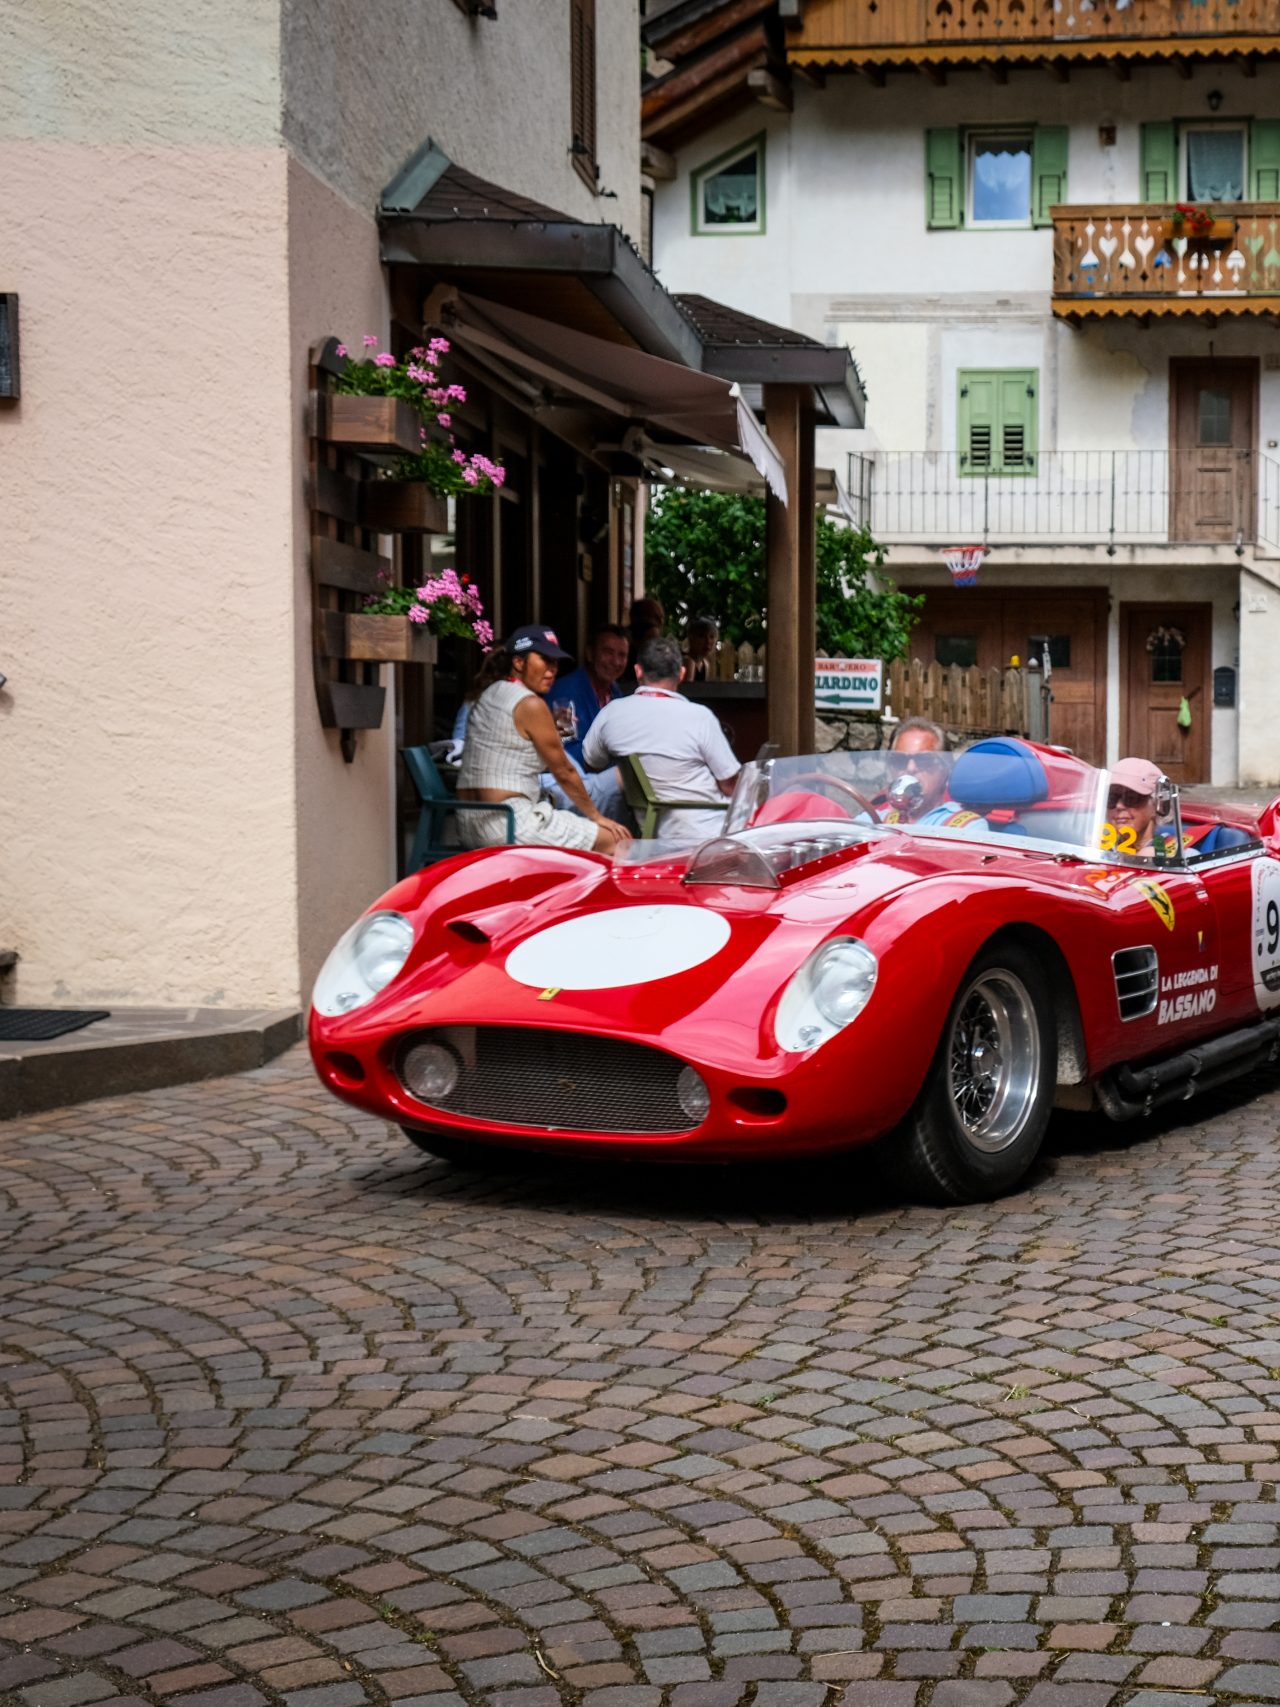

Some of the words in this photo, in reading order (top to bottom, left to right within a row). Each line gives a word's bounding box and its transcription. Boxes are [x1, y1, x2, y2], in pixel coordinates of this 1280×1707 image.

[815, 676, 878, 691] IARDINO
[1098, 823, 1138, 855] 92
[1161, 976, 1172, 992] LA
[1173, 968, 1209, 989] LEGGENDA
[1210, 965, 1219, 981] DI
[1157, 988, 1217, 1025] BASSANO
